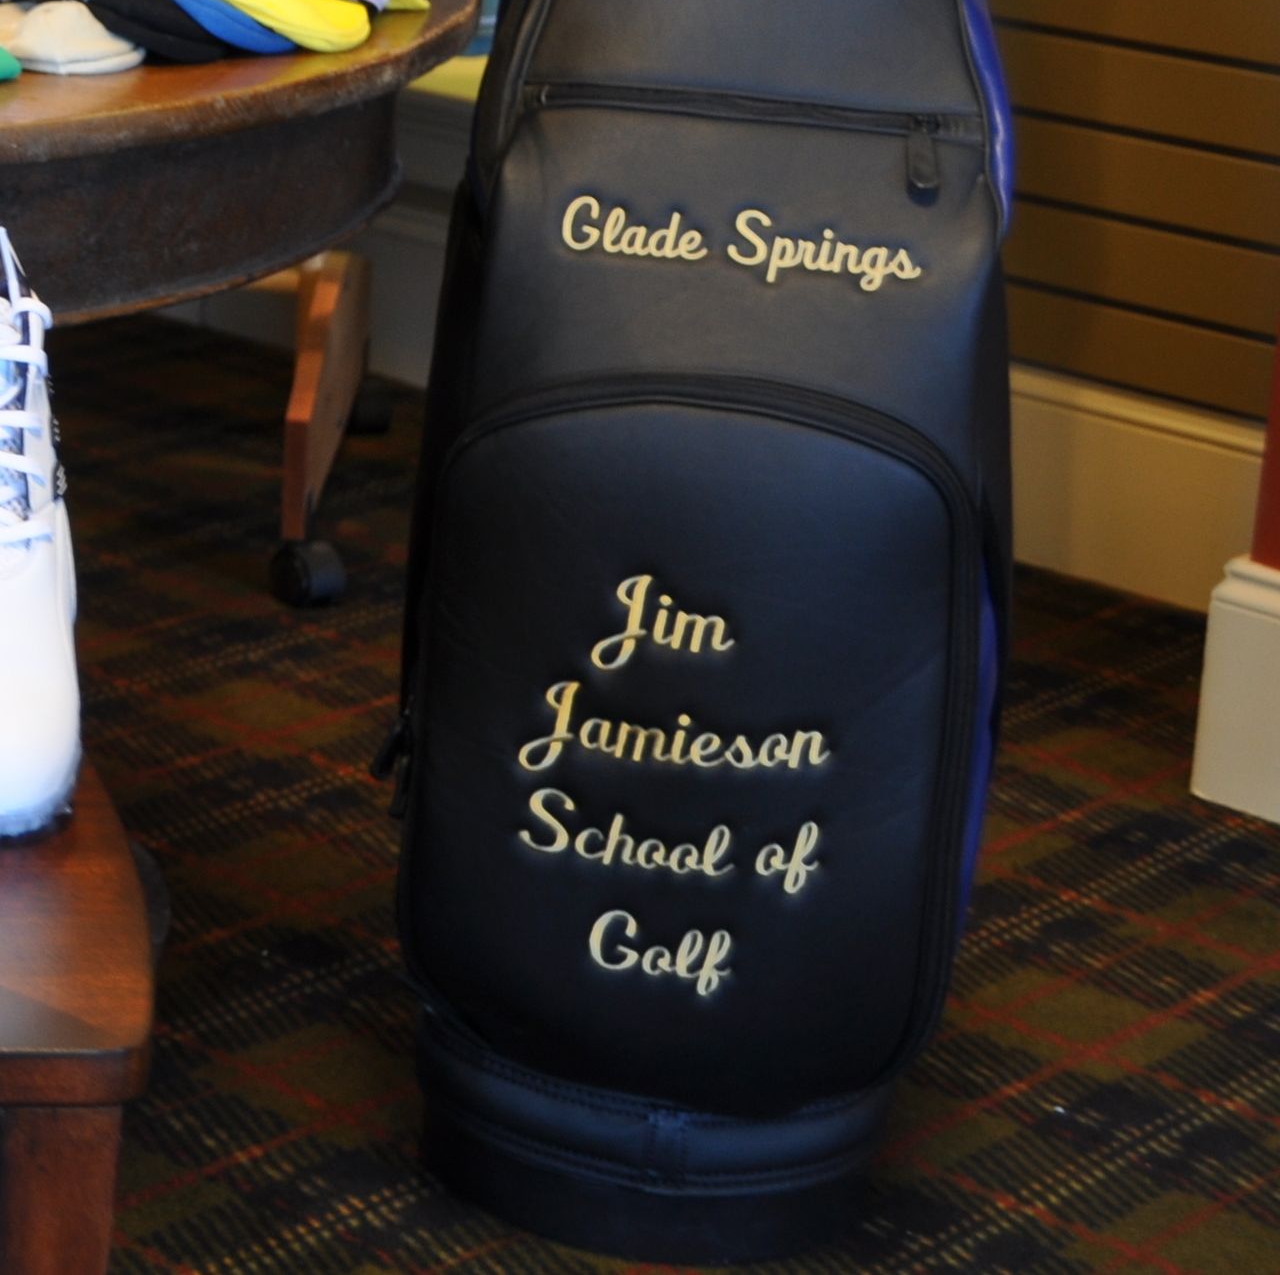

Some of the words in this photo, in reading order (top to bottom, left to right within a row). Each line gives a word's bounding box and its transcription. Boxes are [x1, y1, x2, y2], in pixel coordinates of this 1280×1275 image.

[560, 195, 709, 262] Glade
[726, 208, 923, 293] Springs
[590, 573, 736, 671] Jim
[517, 680, 832, 773] Jamieson
[518, 786, 735, 877] School
[754, 820, 820, 895] of
[589, 909, 733, 997] Golf
